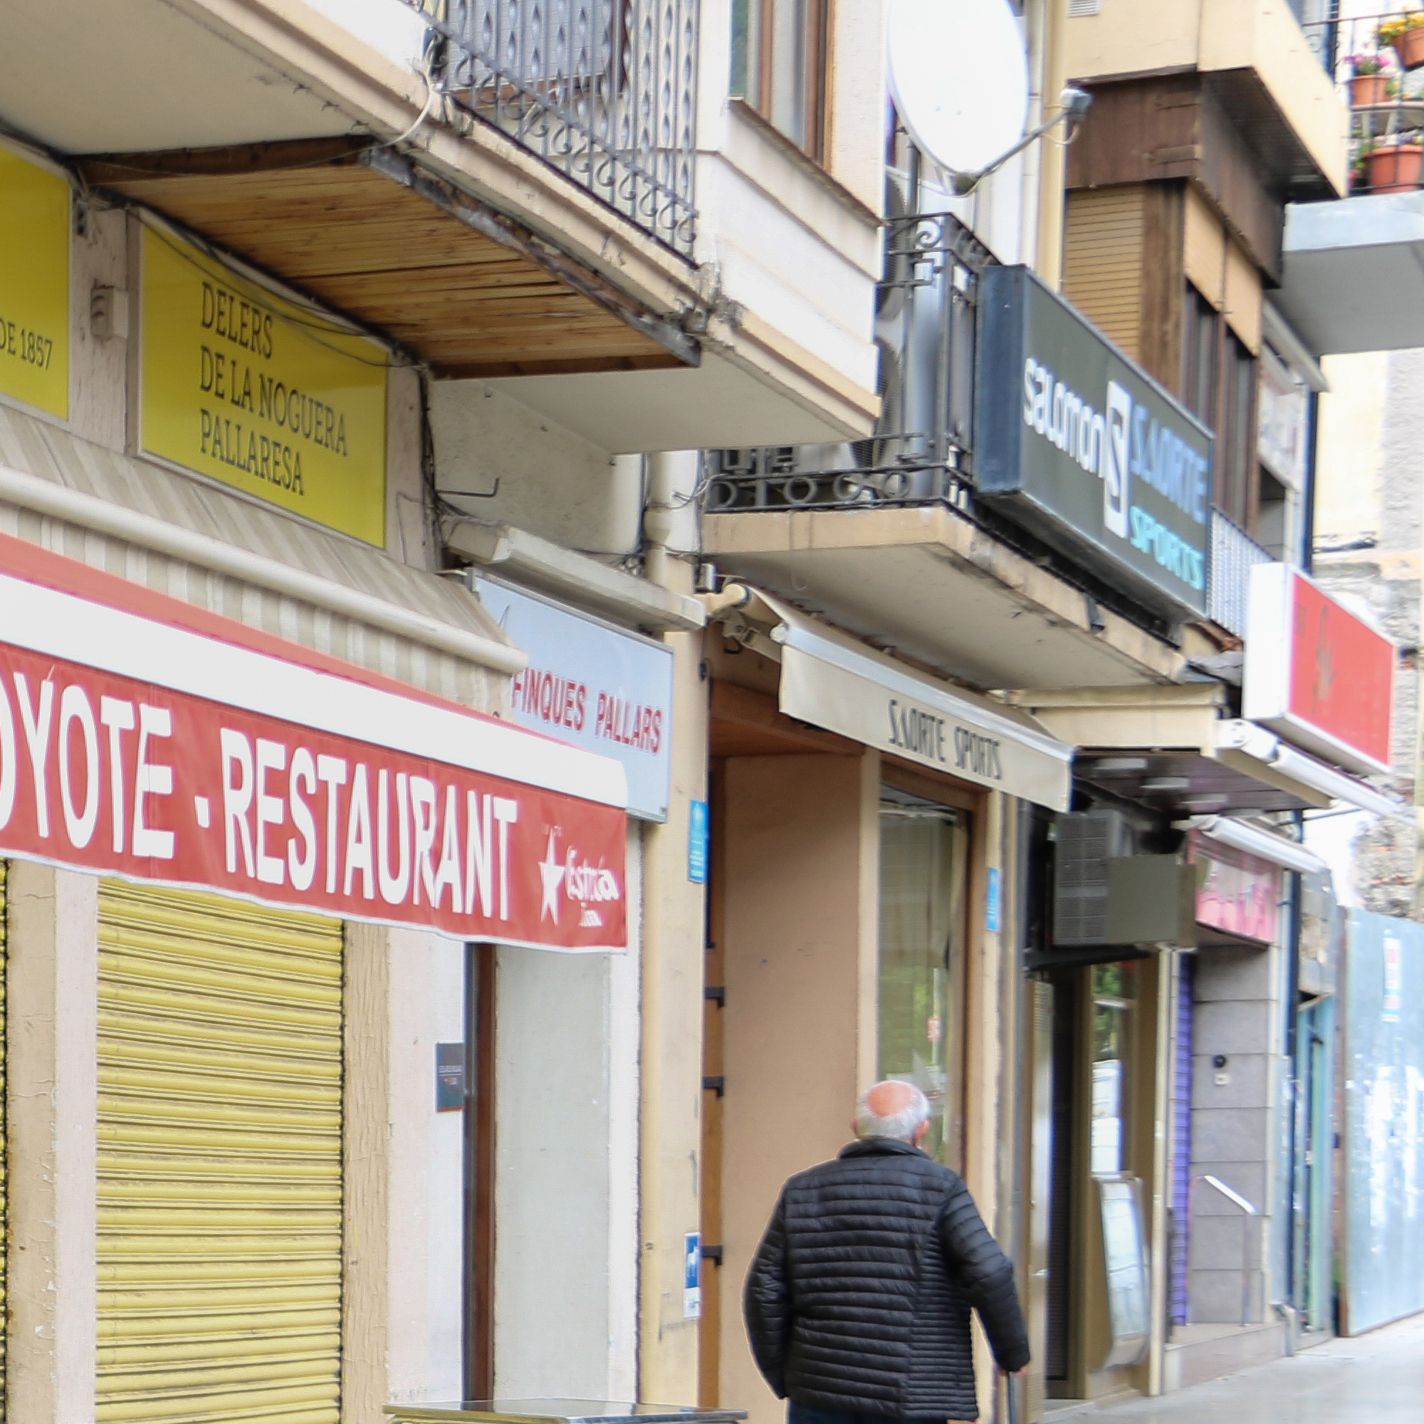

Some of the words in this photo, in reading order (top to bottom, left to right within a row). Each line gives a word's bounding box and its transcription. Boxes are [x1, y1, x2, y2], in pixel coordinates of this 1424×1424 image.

[20, 330, 53, 371] 1857
[201, 281, 273, 359] DELERS
[200, 345, 225, 399] DE
[230, 359, 254, 413] LA
[258, 373, 348, 457] NOGUERA
[1024, 357, 1106, 478] salomon
[200, 408, 305, 496] PALLARESA
[1130, 506, 1203, 589] SPORTS
[511, 667, 587, 731] FINQUES
[595, 693, 663, 755] PALLARS
[954, 726, 1001, 779] SPORTS
[220, 728, 518, 920] RESTAURANT
